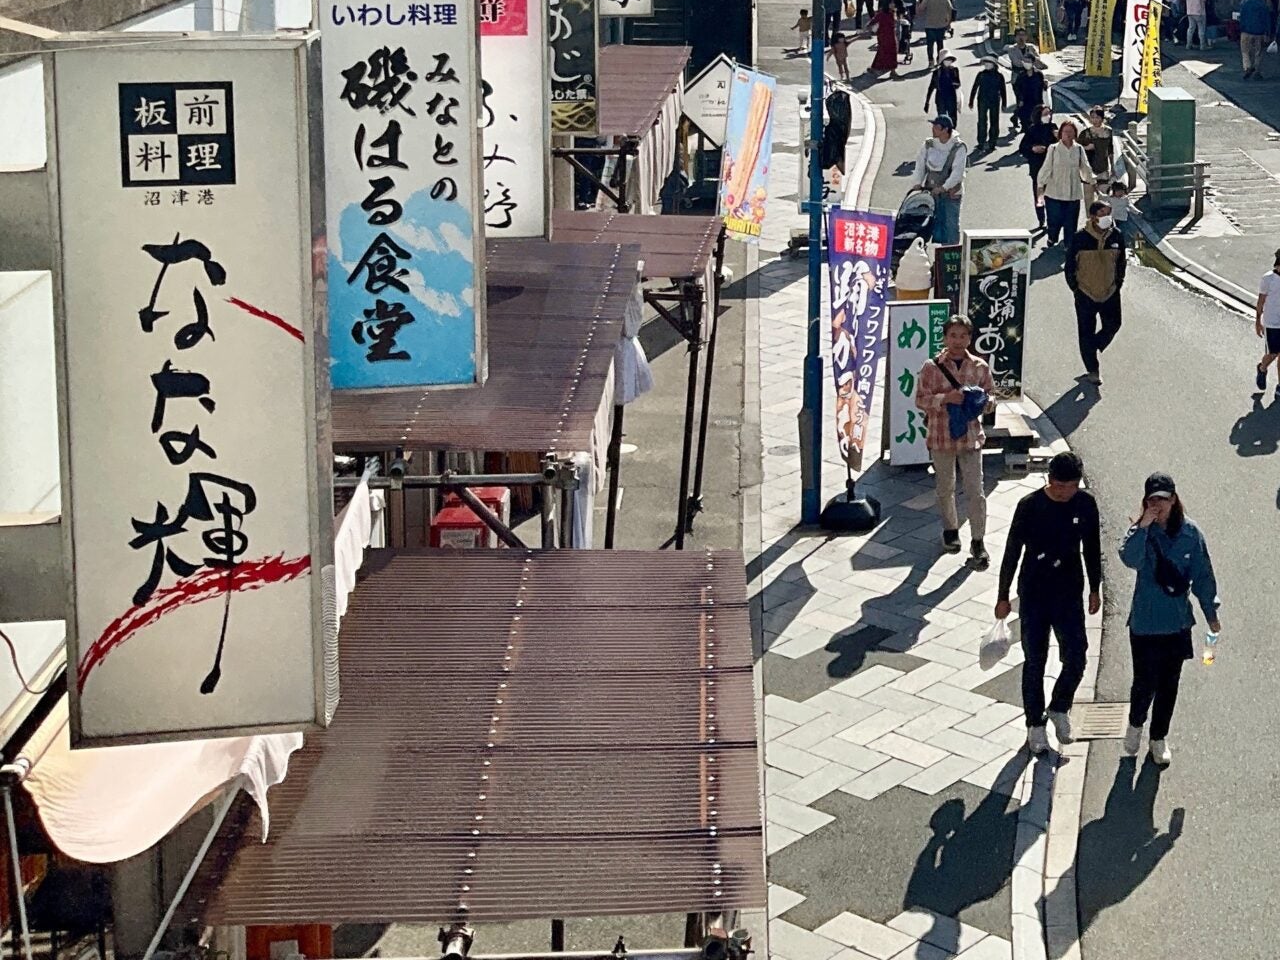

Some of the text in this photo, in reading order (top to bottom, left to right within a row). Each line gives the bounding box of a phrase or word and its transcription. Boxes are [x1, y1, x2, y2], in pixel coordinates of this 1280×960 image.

[332, 3, 457, 26] いわし料理
[425, 53, 460, 202] みなとの
[144, 190, 214, 207] 沼津港
[340, 45, 418, 361] 磯はる食堂
[844, 222, 879, 241] 沼津港
[844, 238, 879, 257] 新名物
[933, 316, 944, 358] ためして
[895, 318, 928, 444] めかぶ
[129, 232, 256, 695] なな輝
